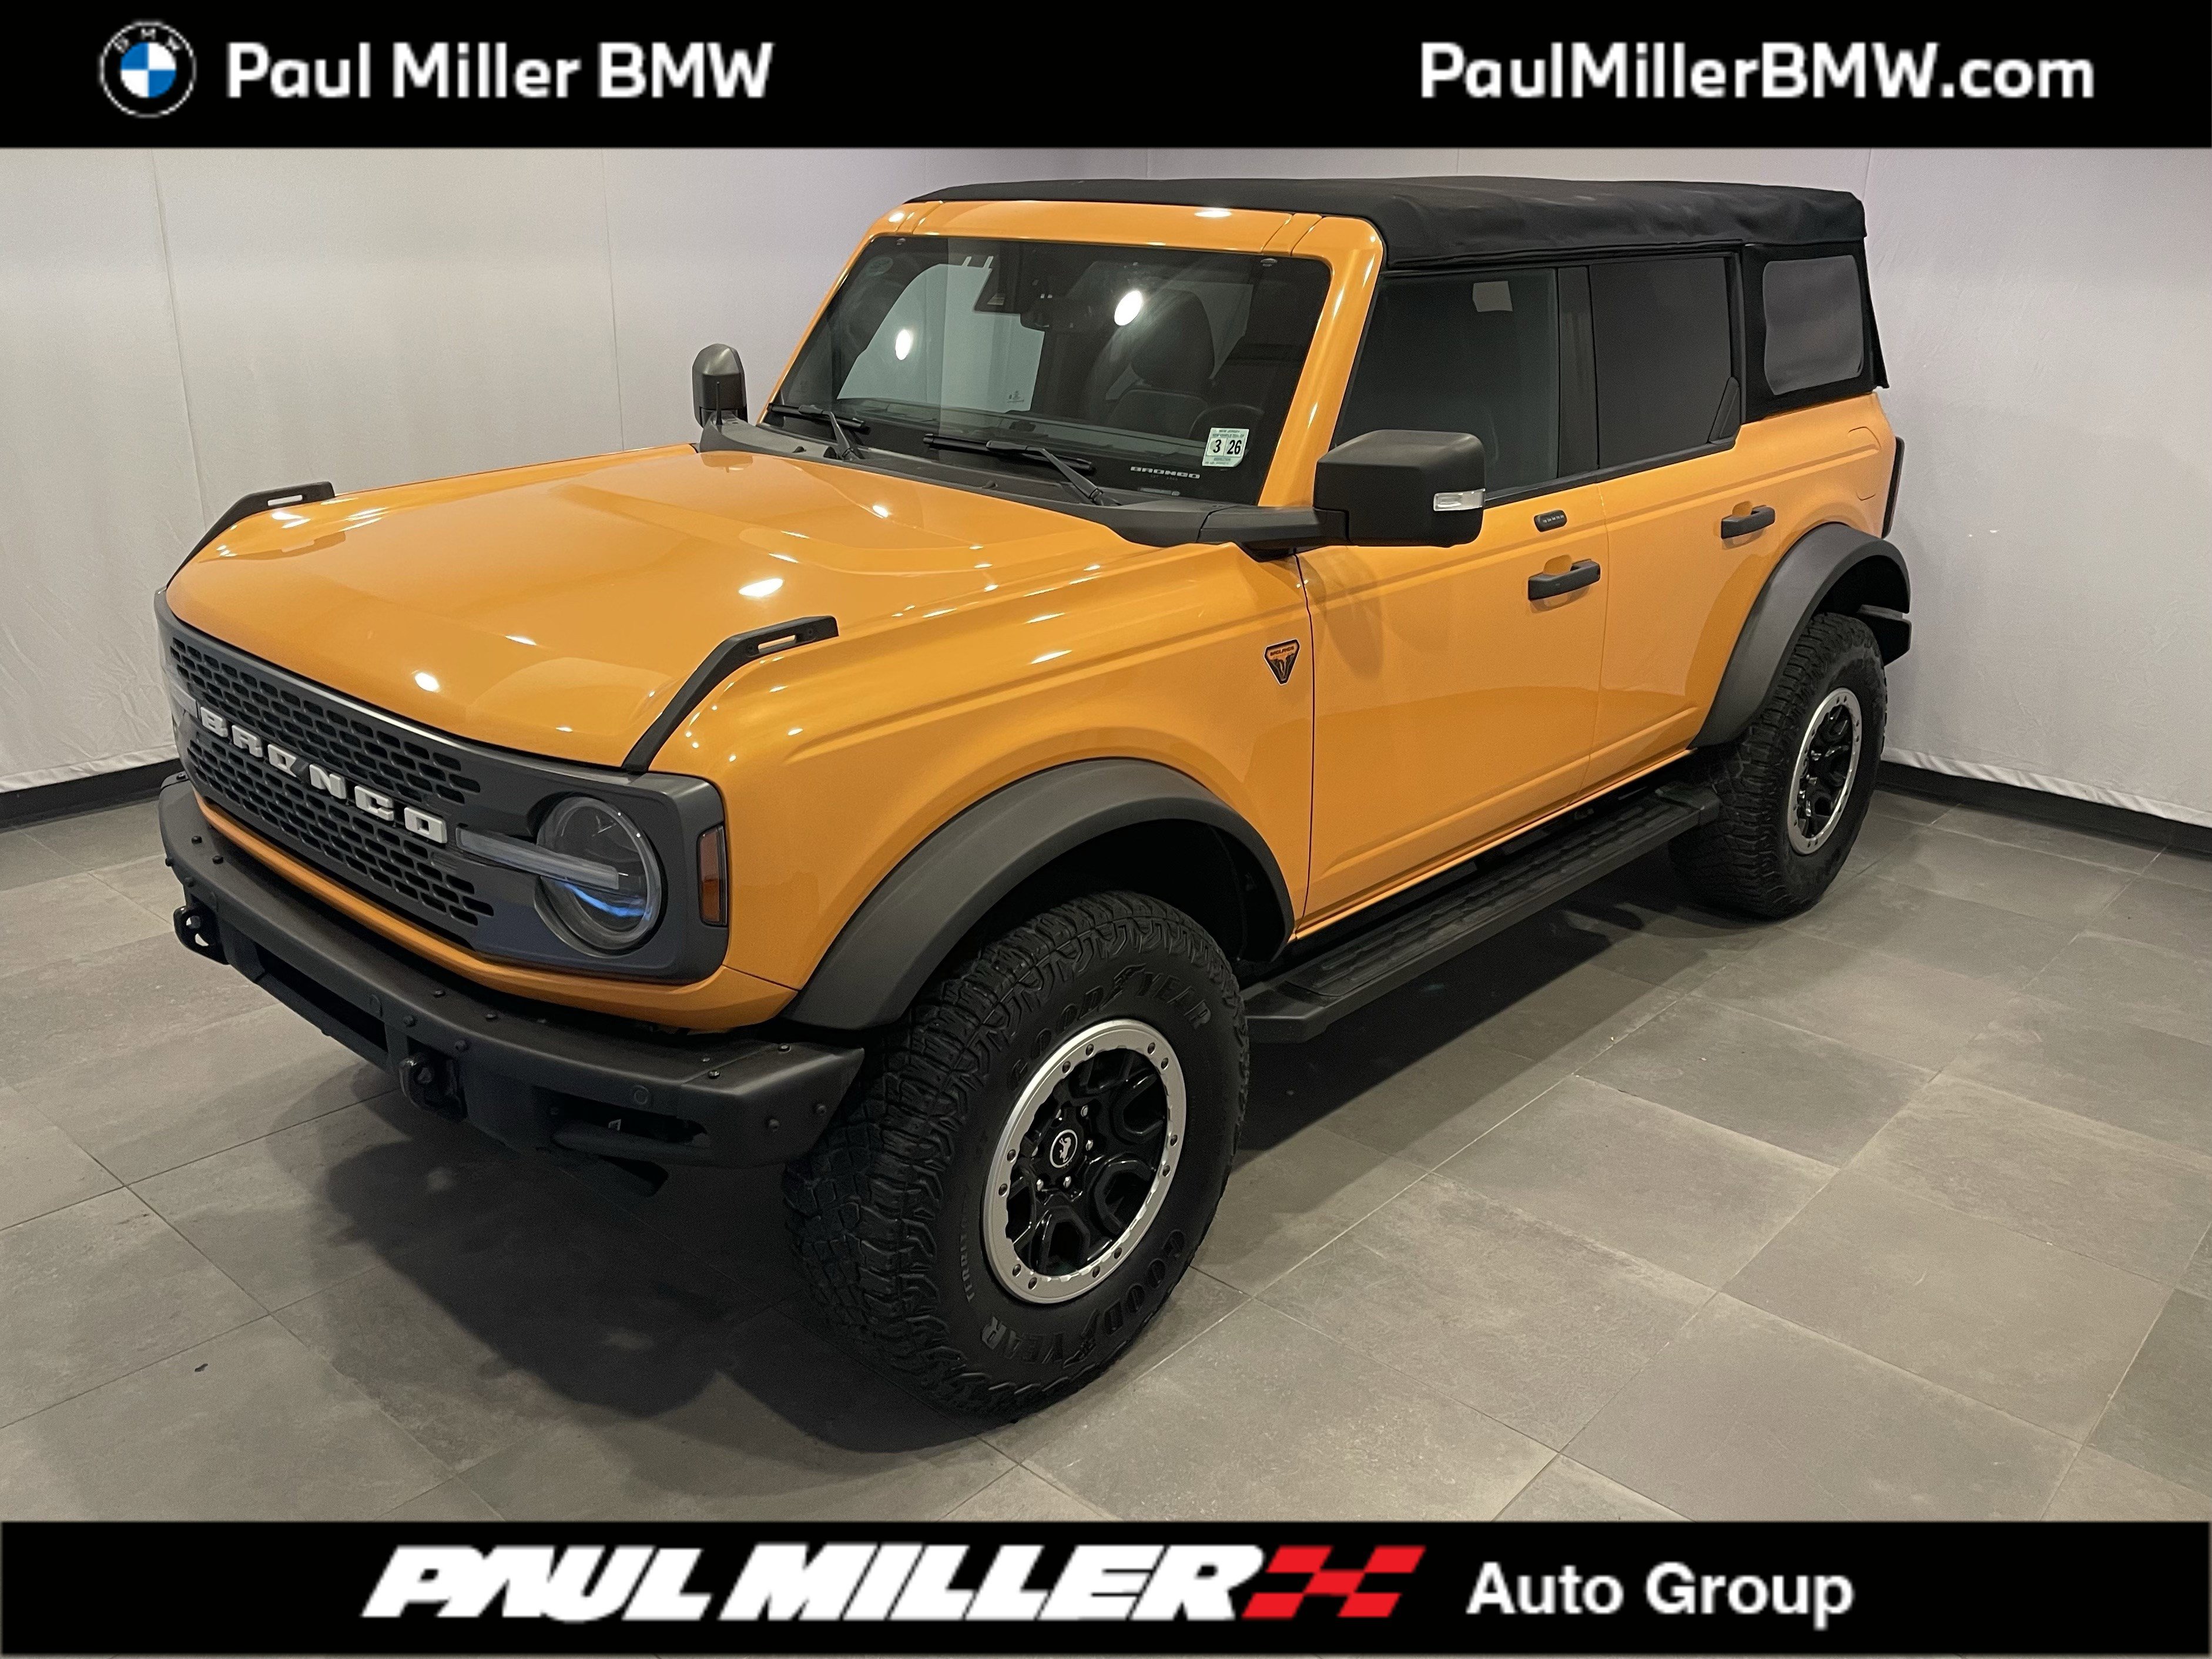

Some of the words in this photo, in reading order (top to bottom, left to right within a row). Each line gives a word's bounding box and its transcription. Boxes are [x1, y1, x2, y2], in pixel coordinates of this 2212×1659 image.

[1213, 439, 1222, 453] 3
[1226, 440, 1242, 455] 26
[1130, 466, 1201, 479] BRONCO
[200, 706, 448, 844] BRONCO
